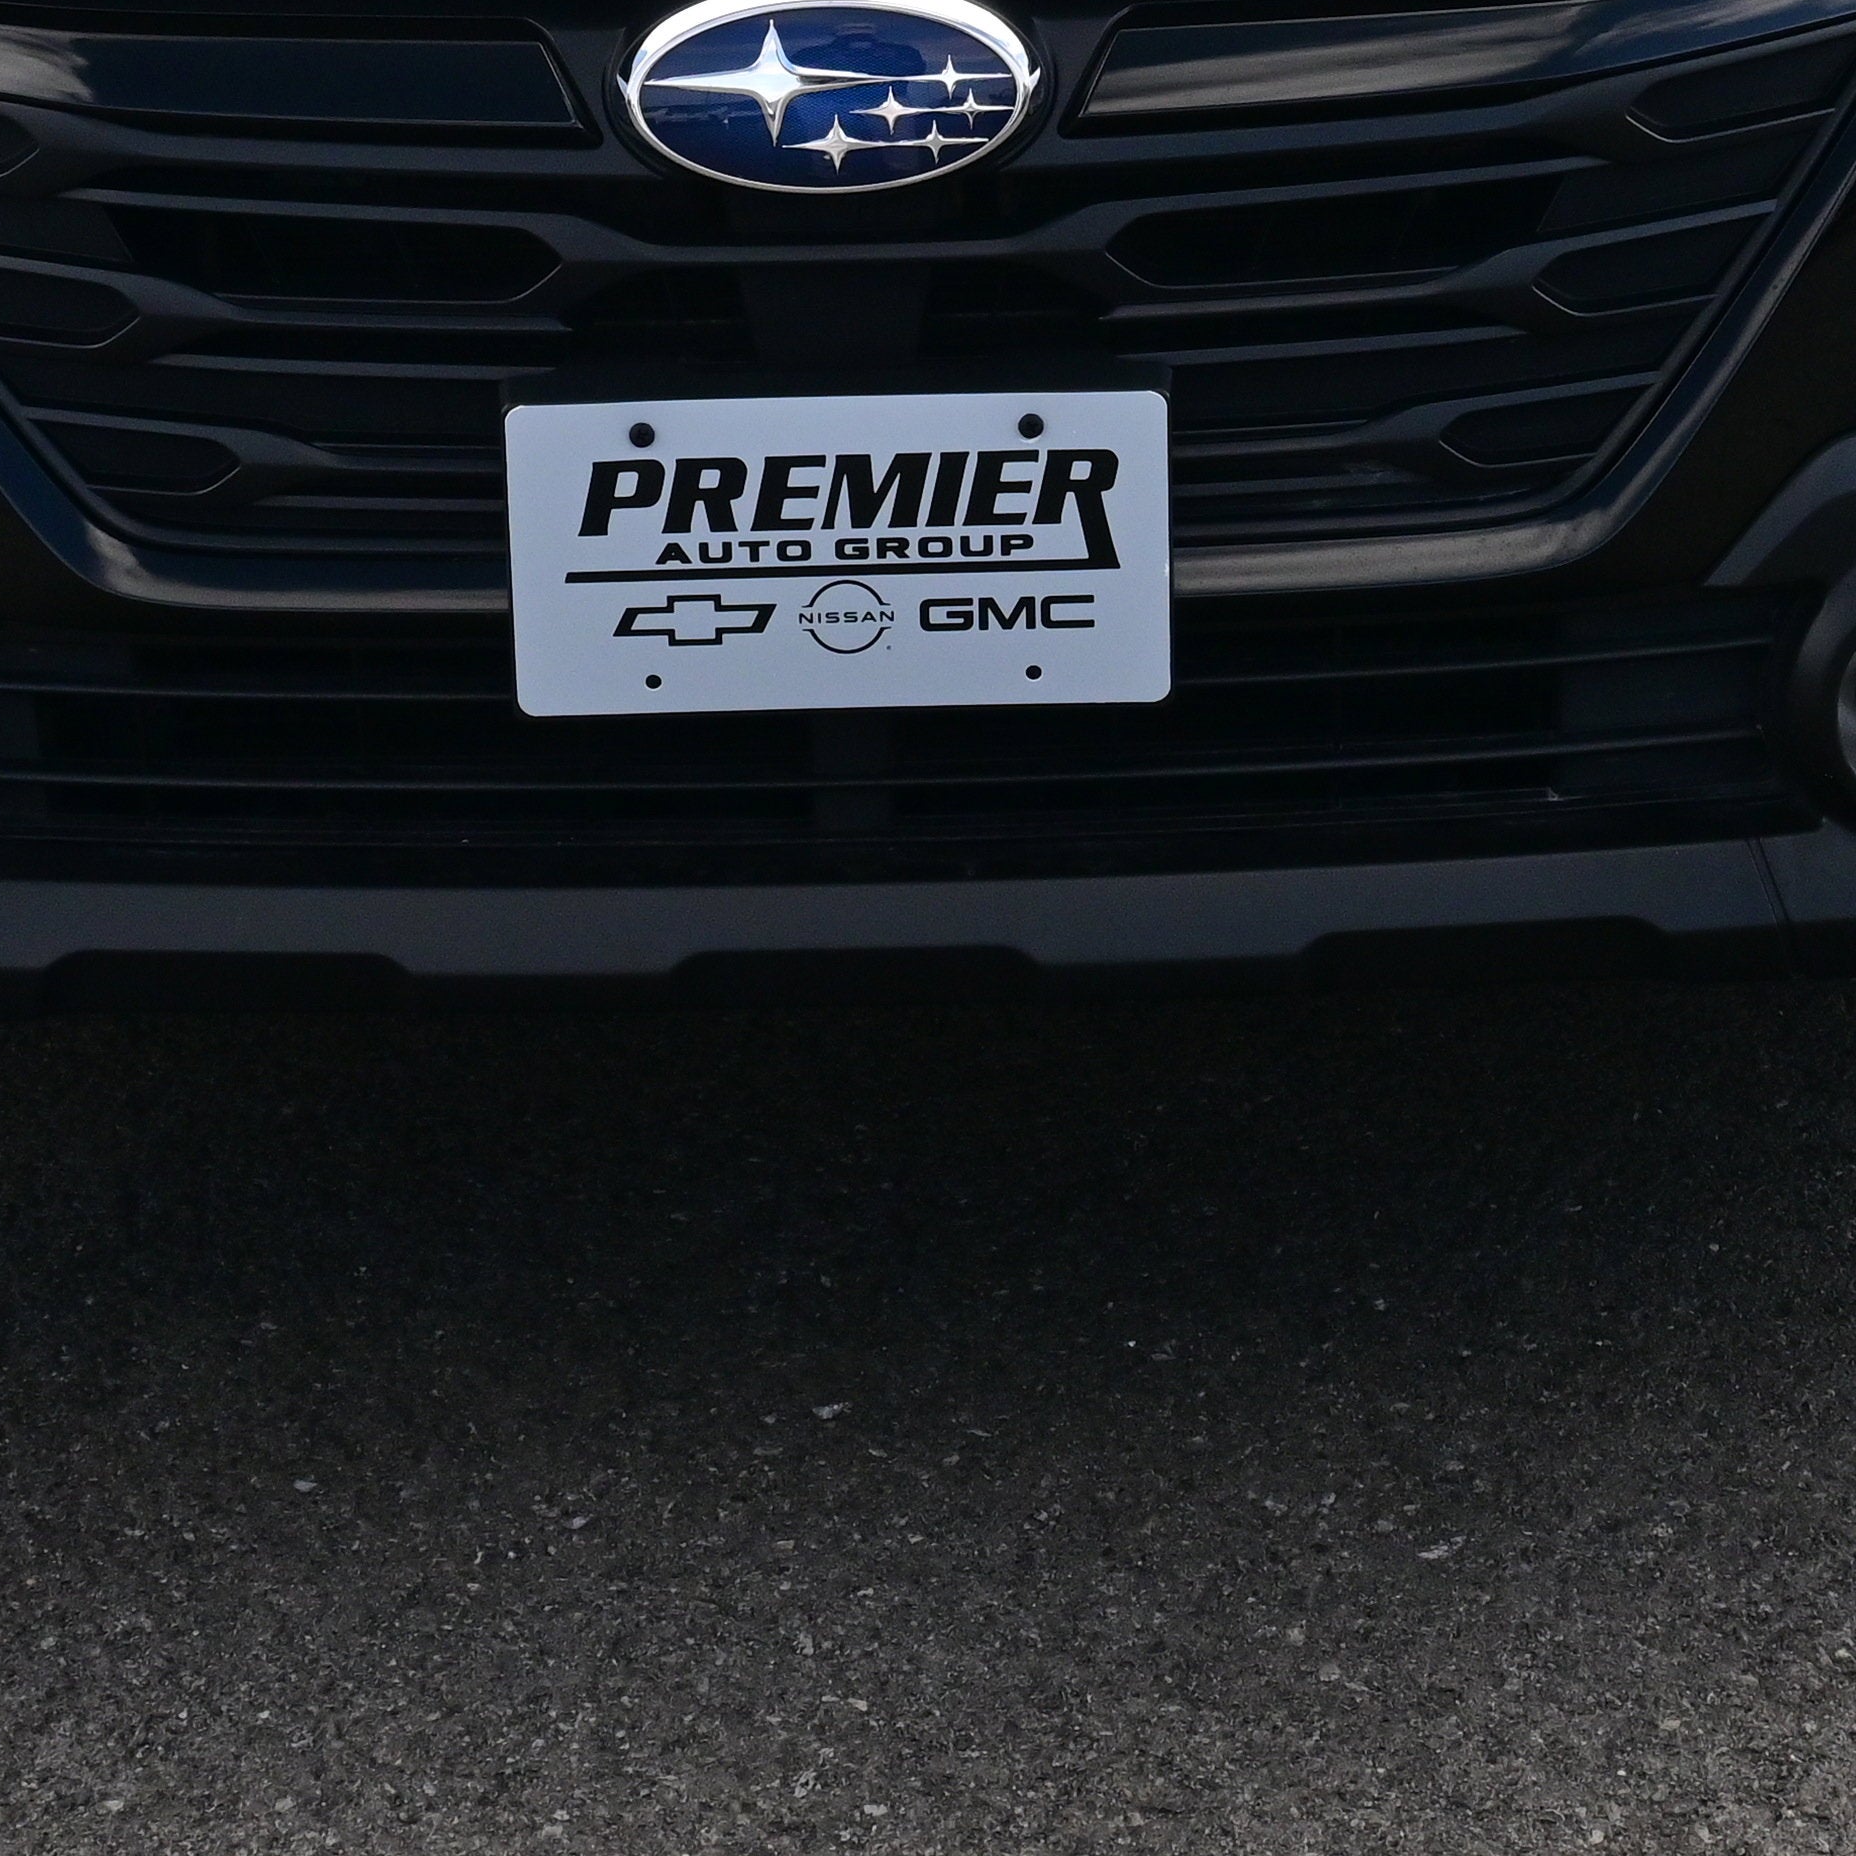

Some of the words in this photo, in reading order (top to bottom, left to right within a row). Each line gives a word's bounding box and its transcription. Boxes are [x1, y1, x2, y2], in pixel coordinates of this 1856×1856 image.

[578, 449, 1120, 562] PREMIER
[655, 539, 813, 565] AUTO
[834, 534, 1035, 561] GROUP
[798, 609, 895, 625] NISSAN
[919, 594, 1095, 632] GMC
